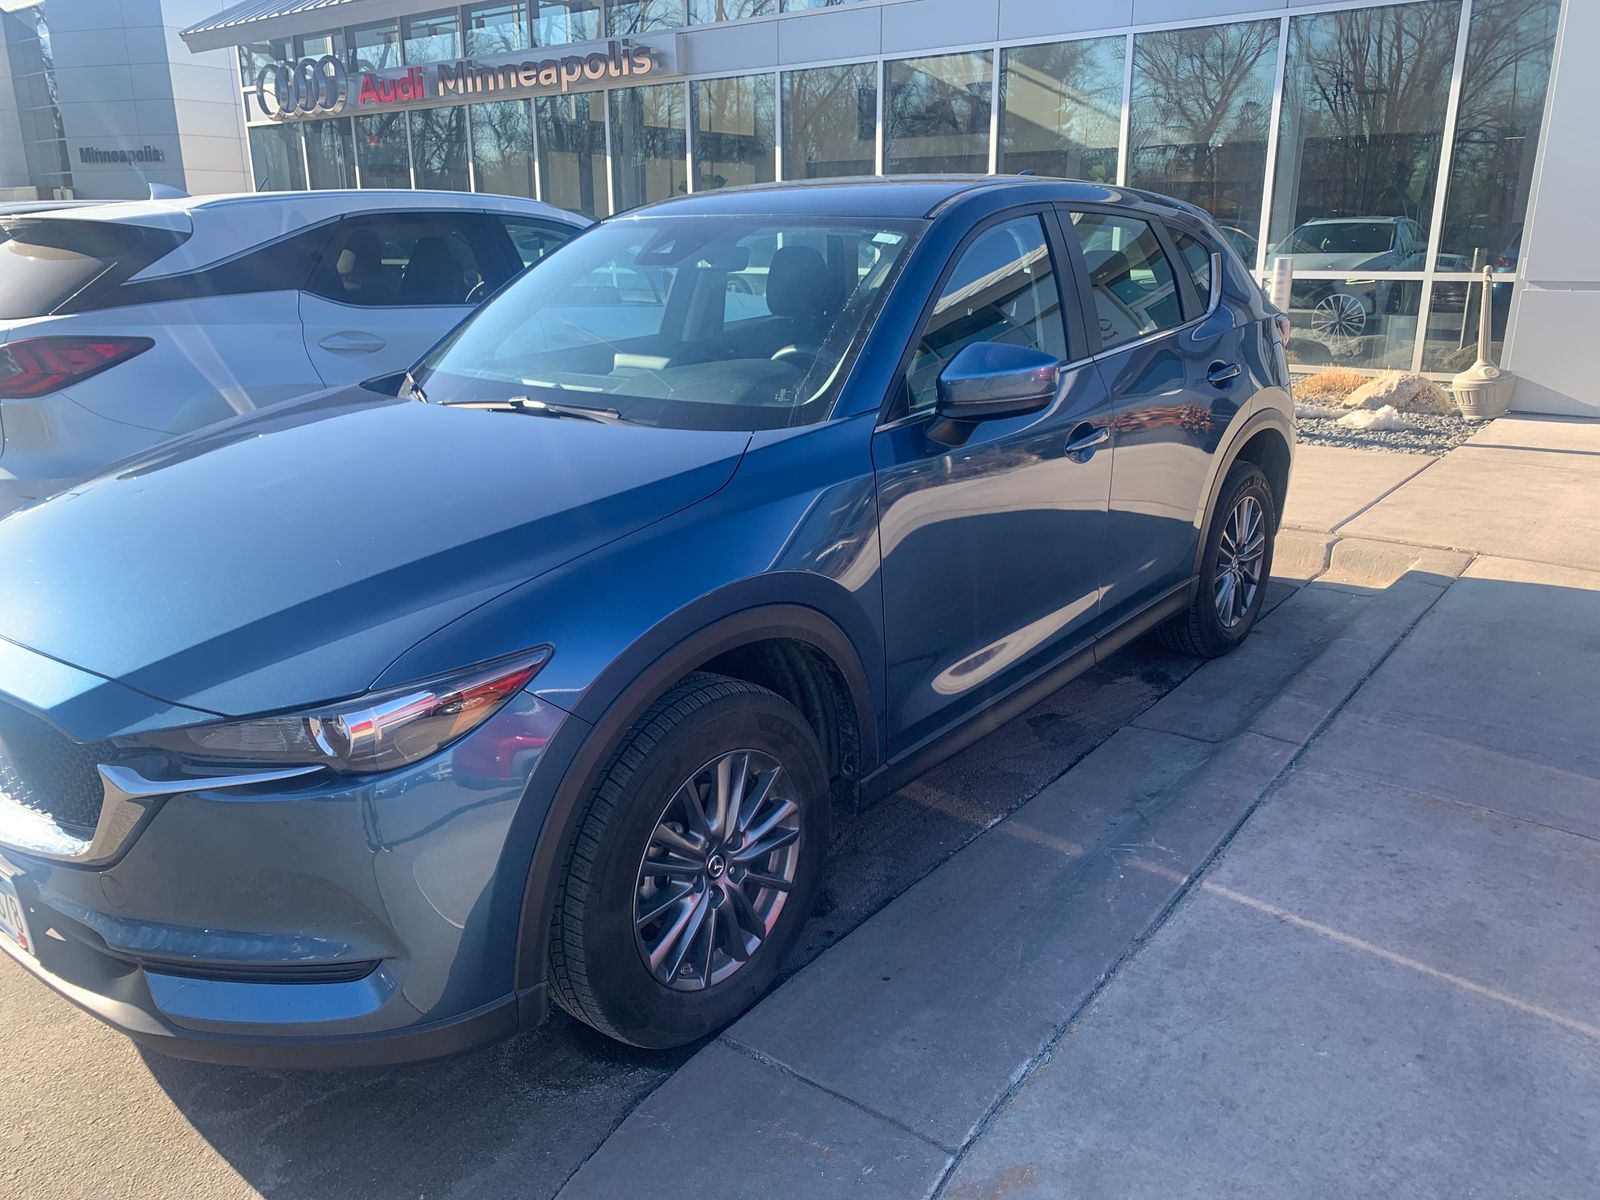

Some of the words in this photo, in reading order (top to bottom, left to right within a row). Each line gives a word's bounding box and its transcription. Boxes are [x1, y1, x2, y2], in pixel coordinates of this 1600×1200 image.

[358, 66, 425, 105] Audi
[437, 38, 653, 92] Minneapolis
[79, 145, 164, 165] Minneapolis
